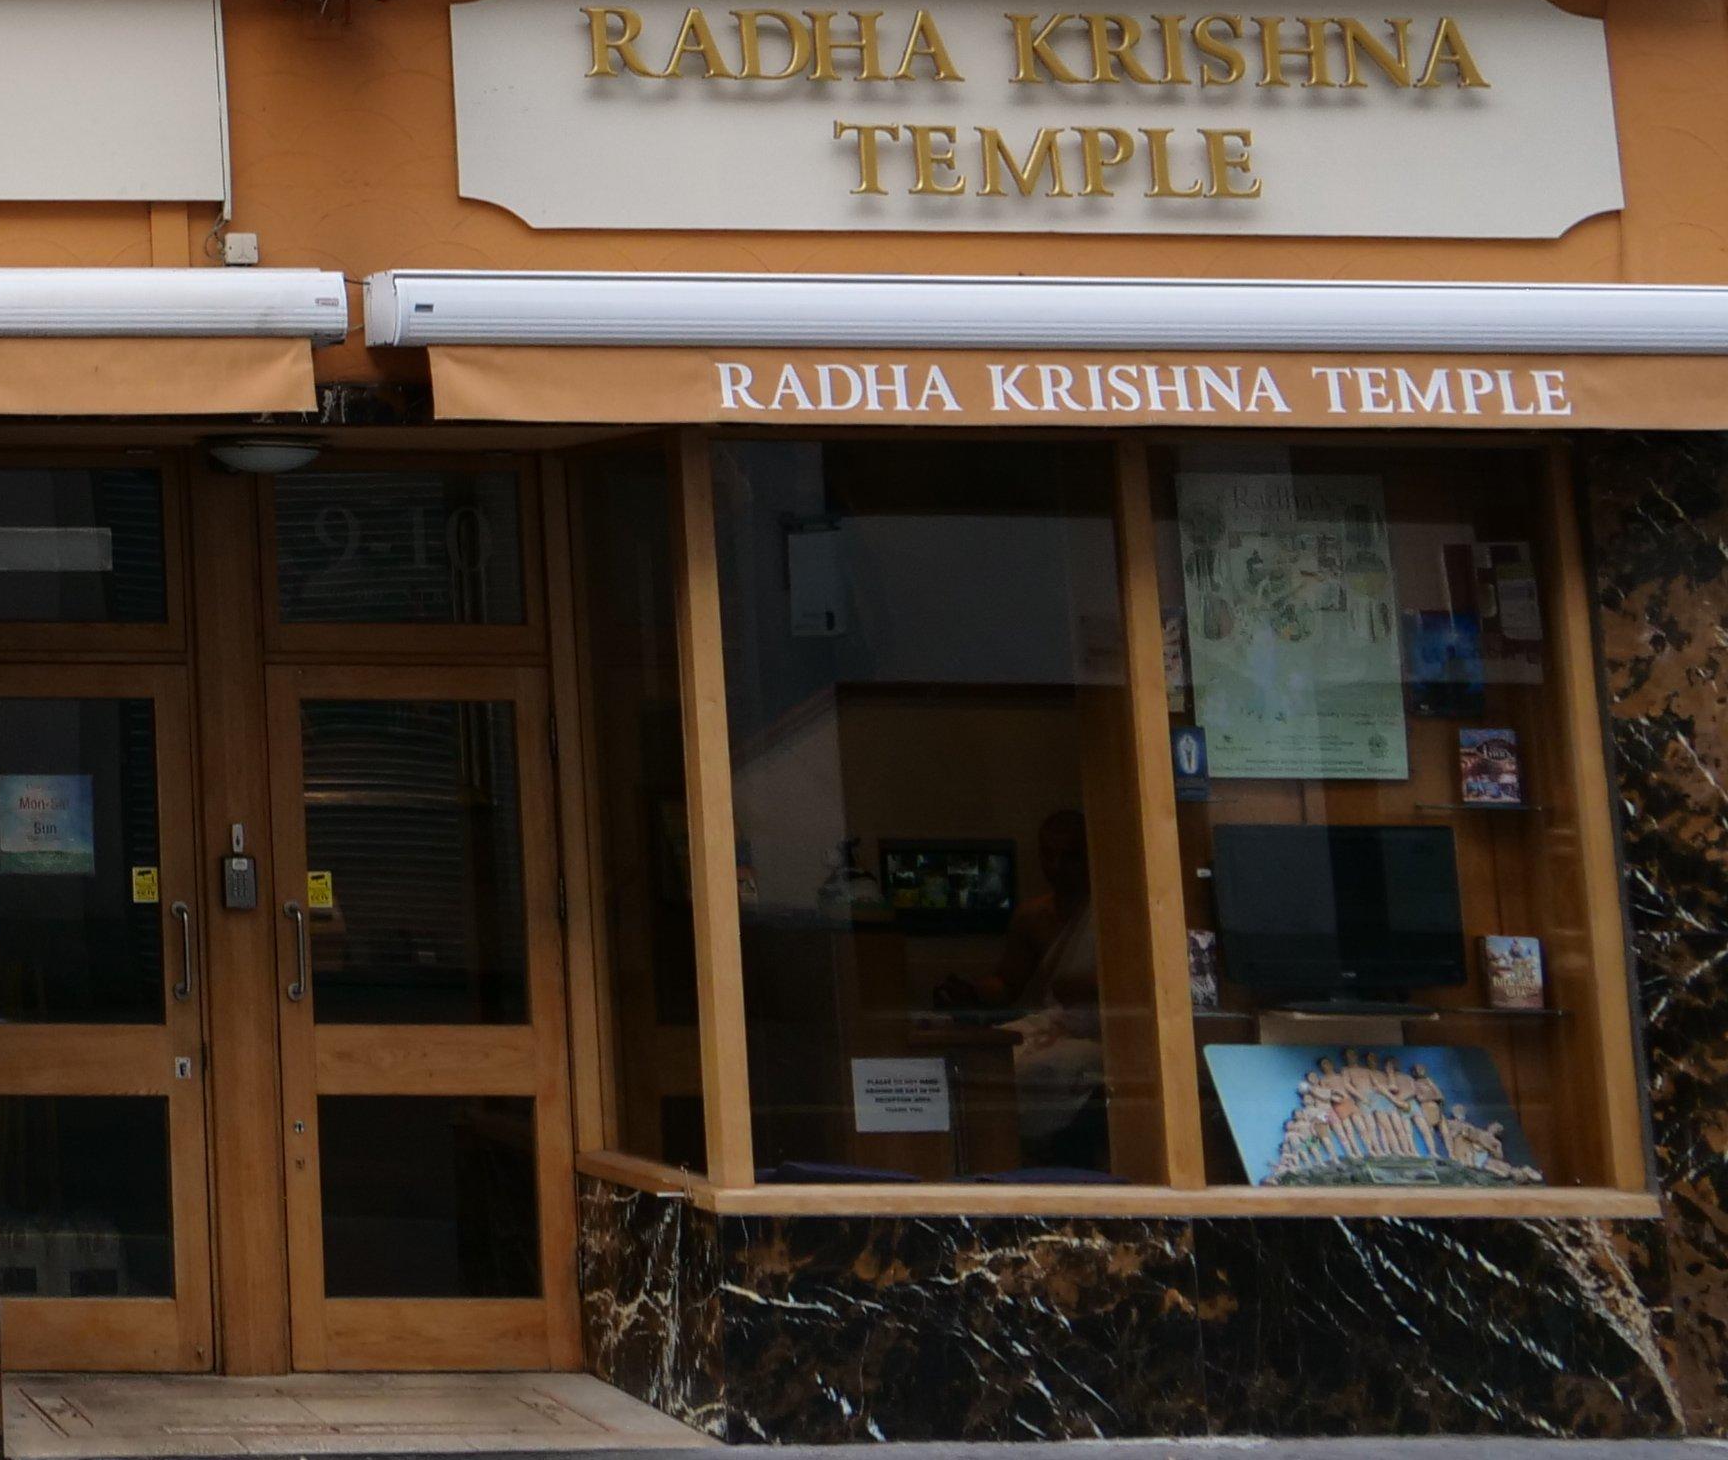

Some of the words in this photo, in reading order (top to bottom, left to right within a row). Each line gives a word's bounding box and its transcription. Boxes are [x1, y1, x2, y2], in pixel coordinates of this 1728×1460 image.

[578, 5, 964, 84] RADHA
[1003, 11, 1490, 90] KRISHNA
[831, 118, 1262, 199] TEMPLE
[714, 361, 963, 412] RADHA
[988, 362, 1290, 414] KRISHNA
[1310, 366, 1573, 417] TEMPLE
